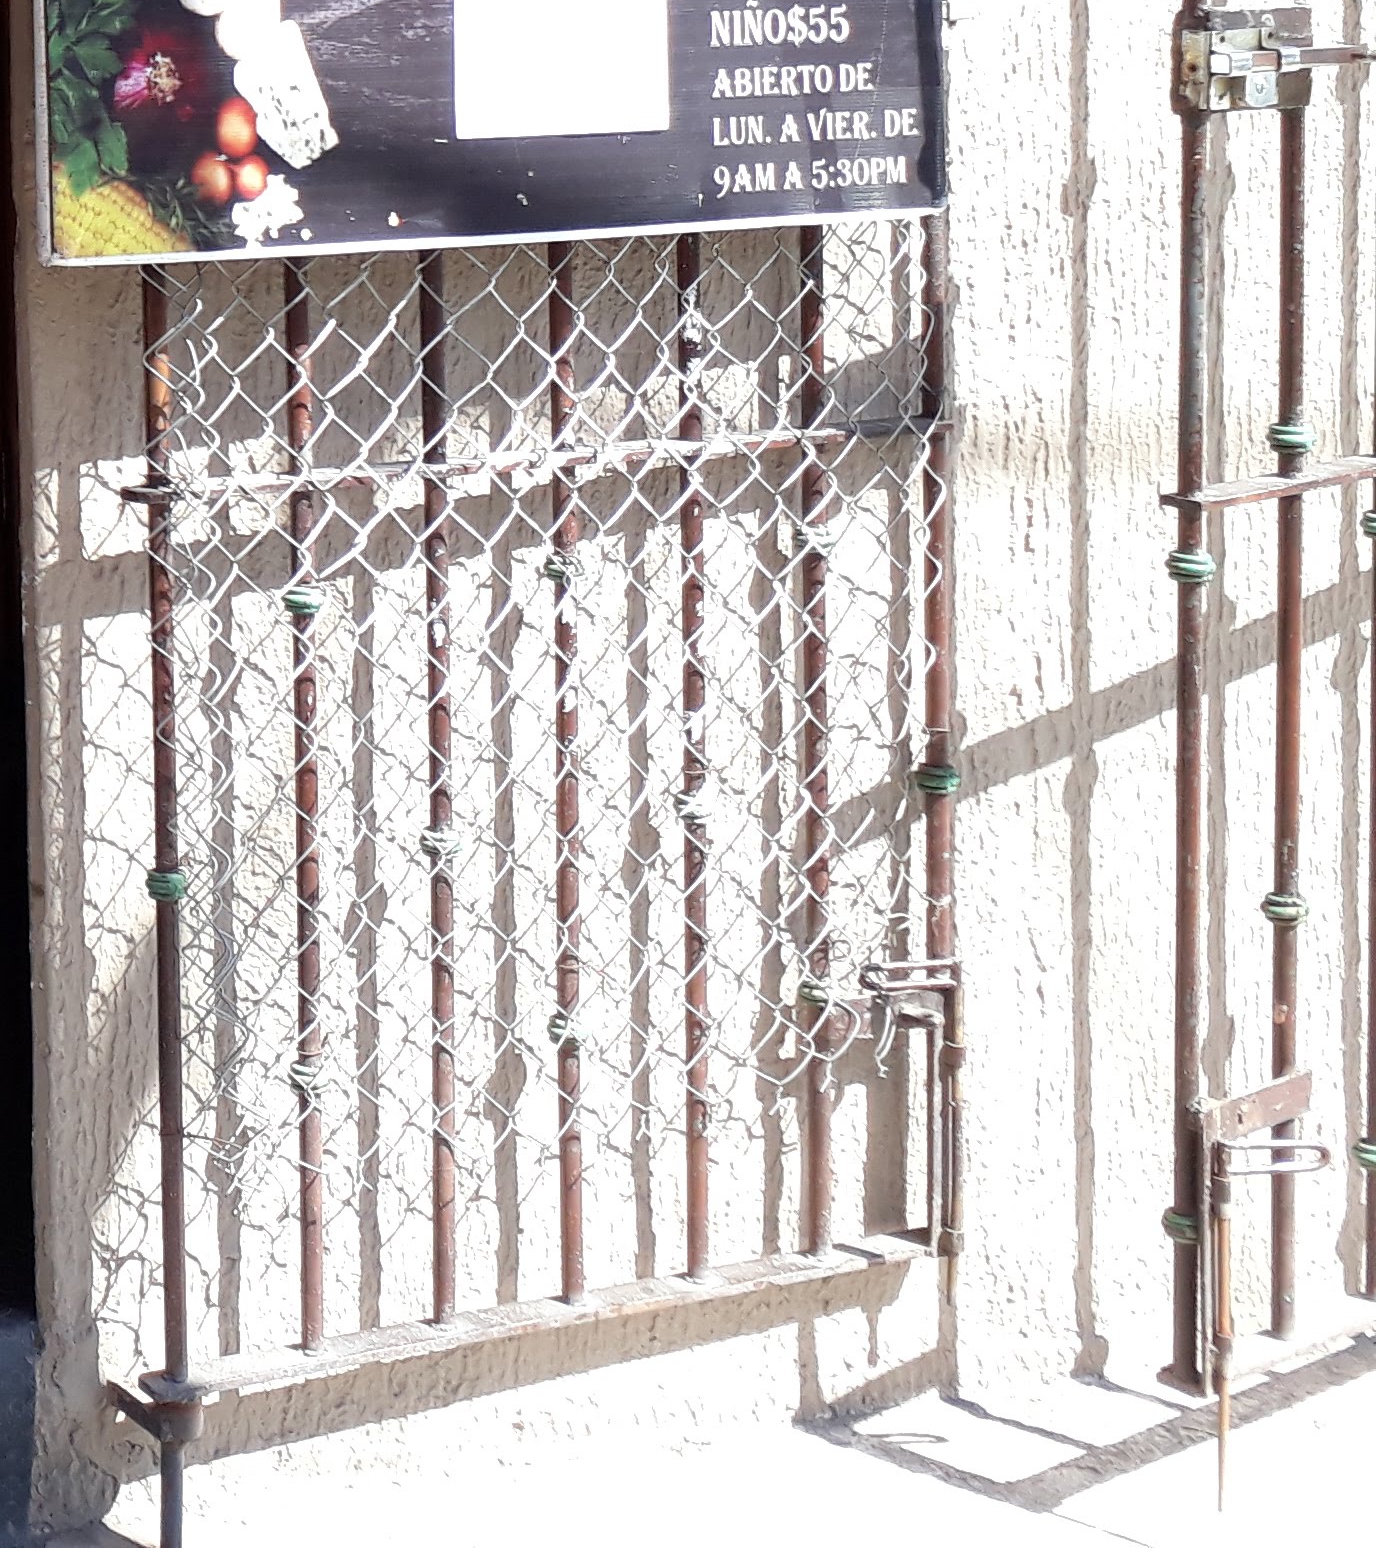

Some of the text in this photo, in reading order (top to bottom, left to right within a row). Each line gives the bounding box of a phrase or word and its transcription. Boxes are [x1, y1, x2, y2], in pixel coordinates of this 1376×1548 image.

[709, 0, 850, 49] NIÑO$55
[712, 61, 875, 100] ABIERTO DE
[712, 107, 921, 148] LUN. A VIER. DE
[713, 154, 908, 200] 9AM A 5:30PM
